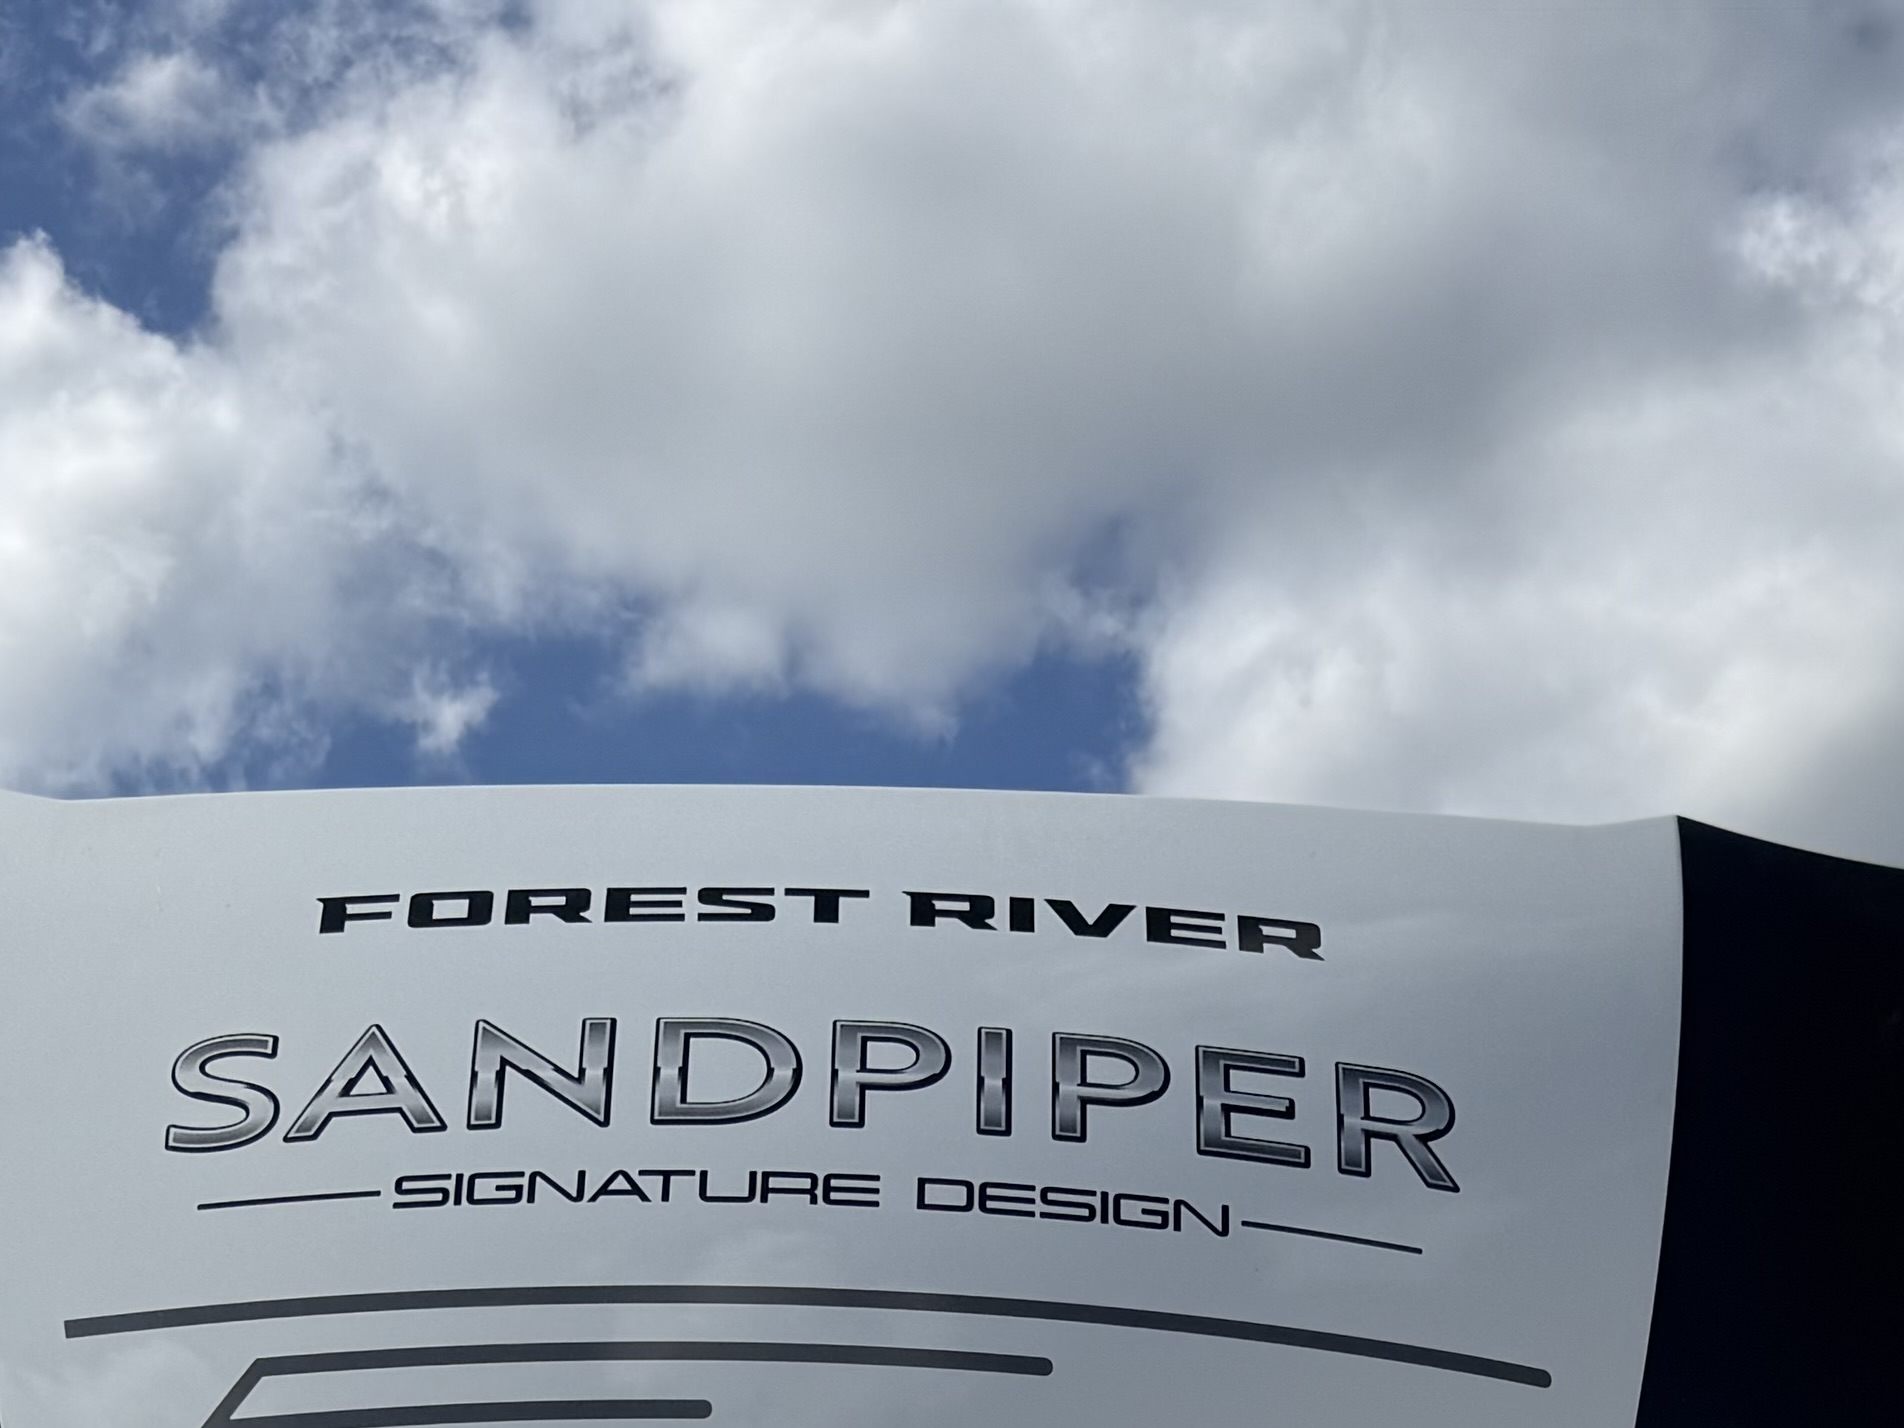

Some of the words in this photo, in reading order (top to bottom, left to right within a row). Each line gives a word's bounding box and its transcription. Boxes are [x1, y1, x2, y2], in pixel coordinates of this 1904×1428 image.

[316, 886, 870, 934] FOREST
[902, 890, 1325, 961] RIVER
[164, 1016, 1460, 1194] SANDPIPER
[392, 1169, 881, 1210] SIGNATURE
[916, 1177, 1230, 1238] DESIGN
